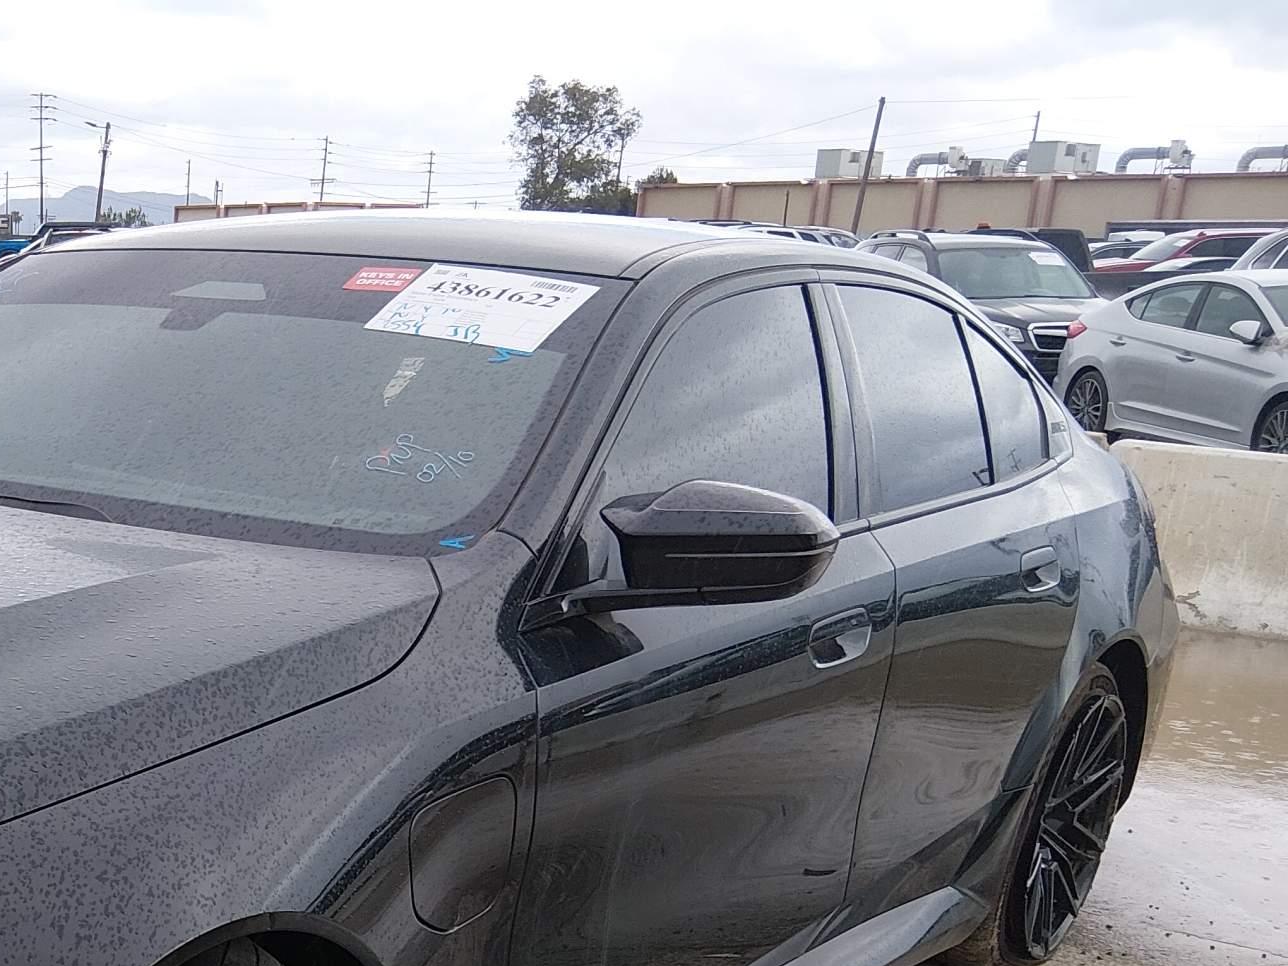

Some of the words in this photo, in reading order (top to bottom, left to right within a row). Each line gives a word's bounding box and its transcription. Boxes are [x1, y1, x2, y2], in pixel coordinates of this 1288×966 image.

[359, 271, 396, 279] KEYS
[398, 272, 414, 280] IN
[355, 279, 406, 287] OFFICE
[427, 280, 561, 308] 43861622
